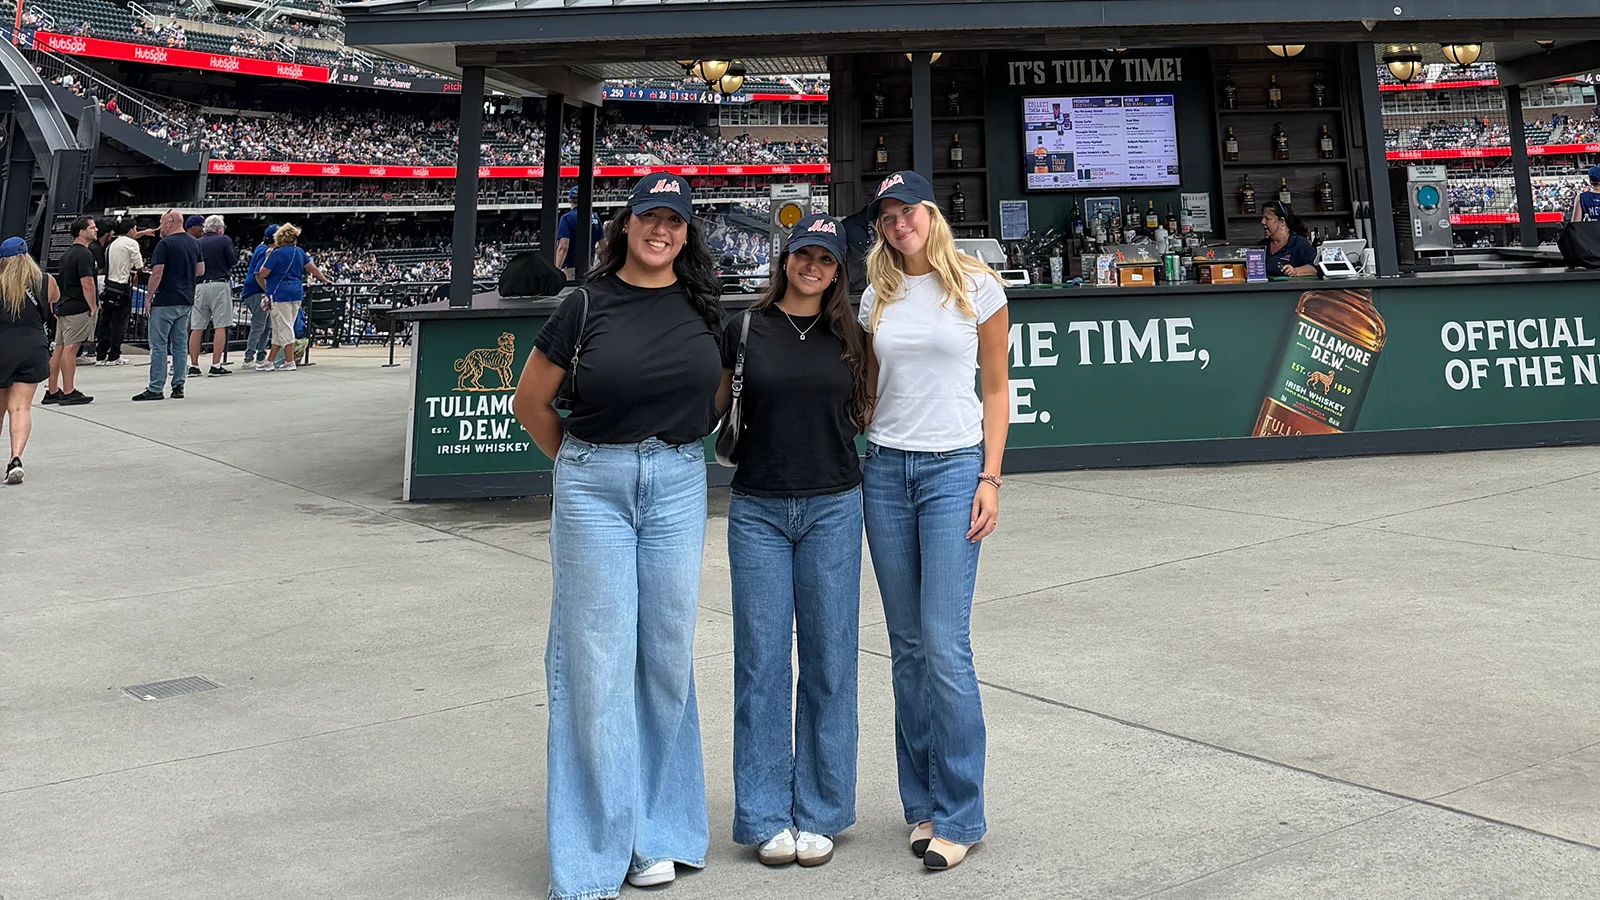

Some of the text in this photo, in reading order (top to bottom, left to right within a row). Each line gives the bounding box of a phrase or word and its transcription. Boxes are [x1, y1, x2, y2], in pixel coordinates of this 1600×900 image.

[49, 36, 86, 52] HubSpot
[135, 47, 167, 62] HubSpot
[210, 56, 239, 71] HubSpot
[277, 63, 303, 78] HubSpot
[1008, 58, 1182, 85] IT'S TULLY TIME!
[638, 91, 644, 99] 9
[650, 179, 681, 195] Mets
[807, 219, 838, 236] Mets
[1067, 317, 1210, 370] TIME,
[1298, 322, 1371, 366] TULLAMORE
[1441, 317, 1596, 352] OFFICIAL
[1311, 345, 1344, 371] D.E.W.
[1291, 362, 1352, 395] EST. 1829
[1445, 354, 1600, 390] OF THE N
[1285, 380, 1307, 395] IRISH
[1308, 390, 1345, 412] WHISKEY
[459, 419, 512, 440] D.E.W.
[437, 442, 530, 454] IRISH WHISKEY
